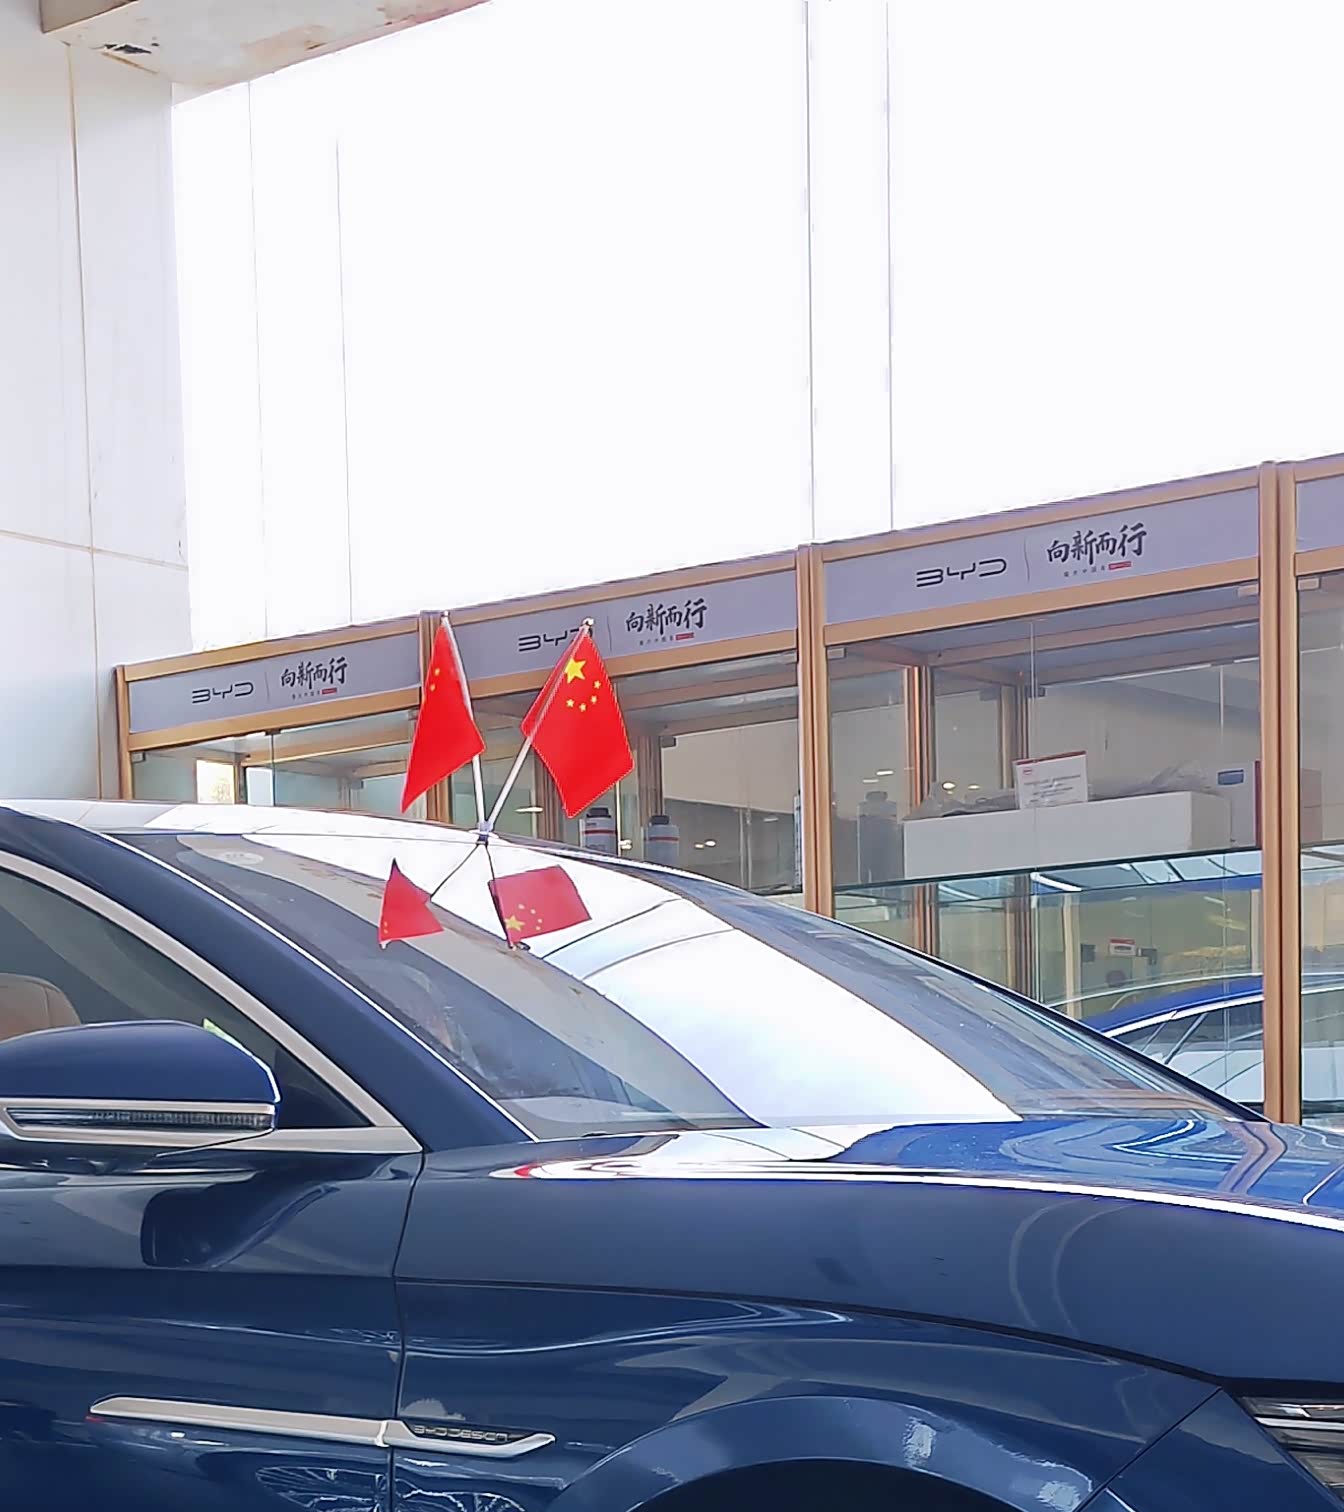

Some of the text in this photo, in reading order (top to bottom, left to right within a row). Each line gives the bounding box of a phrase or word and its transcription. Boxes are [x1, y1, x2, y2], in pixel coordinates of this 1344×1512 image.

[1046, 522, 1148, 565] 向新而行
[915, 558, 1008, 588] BYD
[625, 598, 708, 636] 向新而行
[518, 628, 580, 652] BY
[280, 656, 348, 690] 向新而行
[191, 681, 255, 704] BYD
